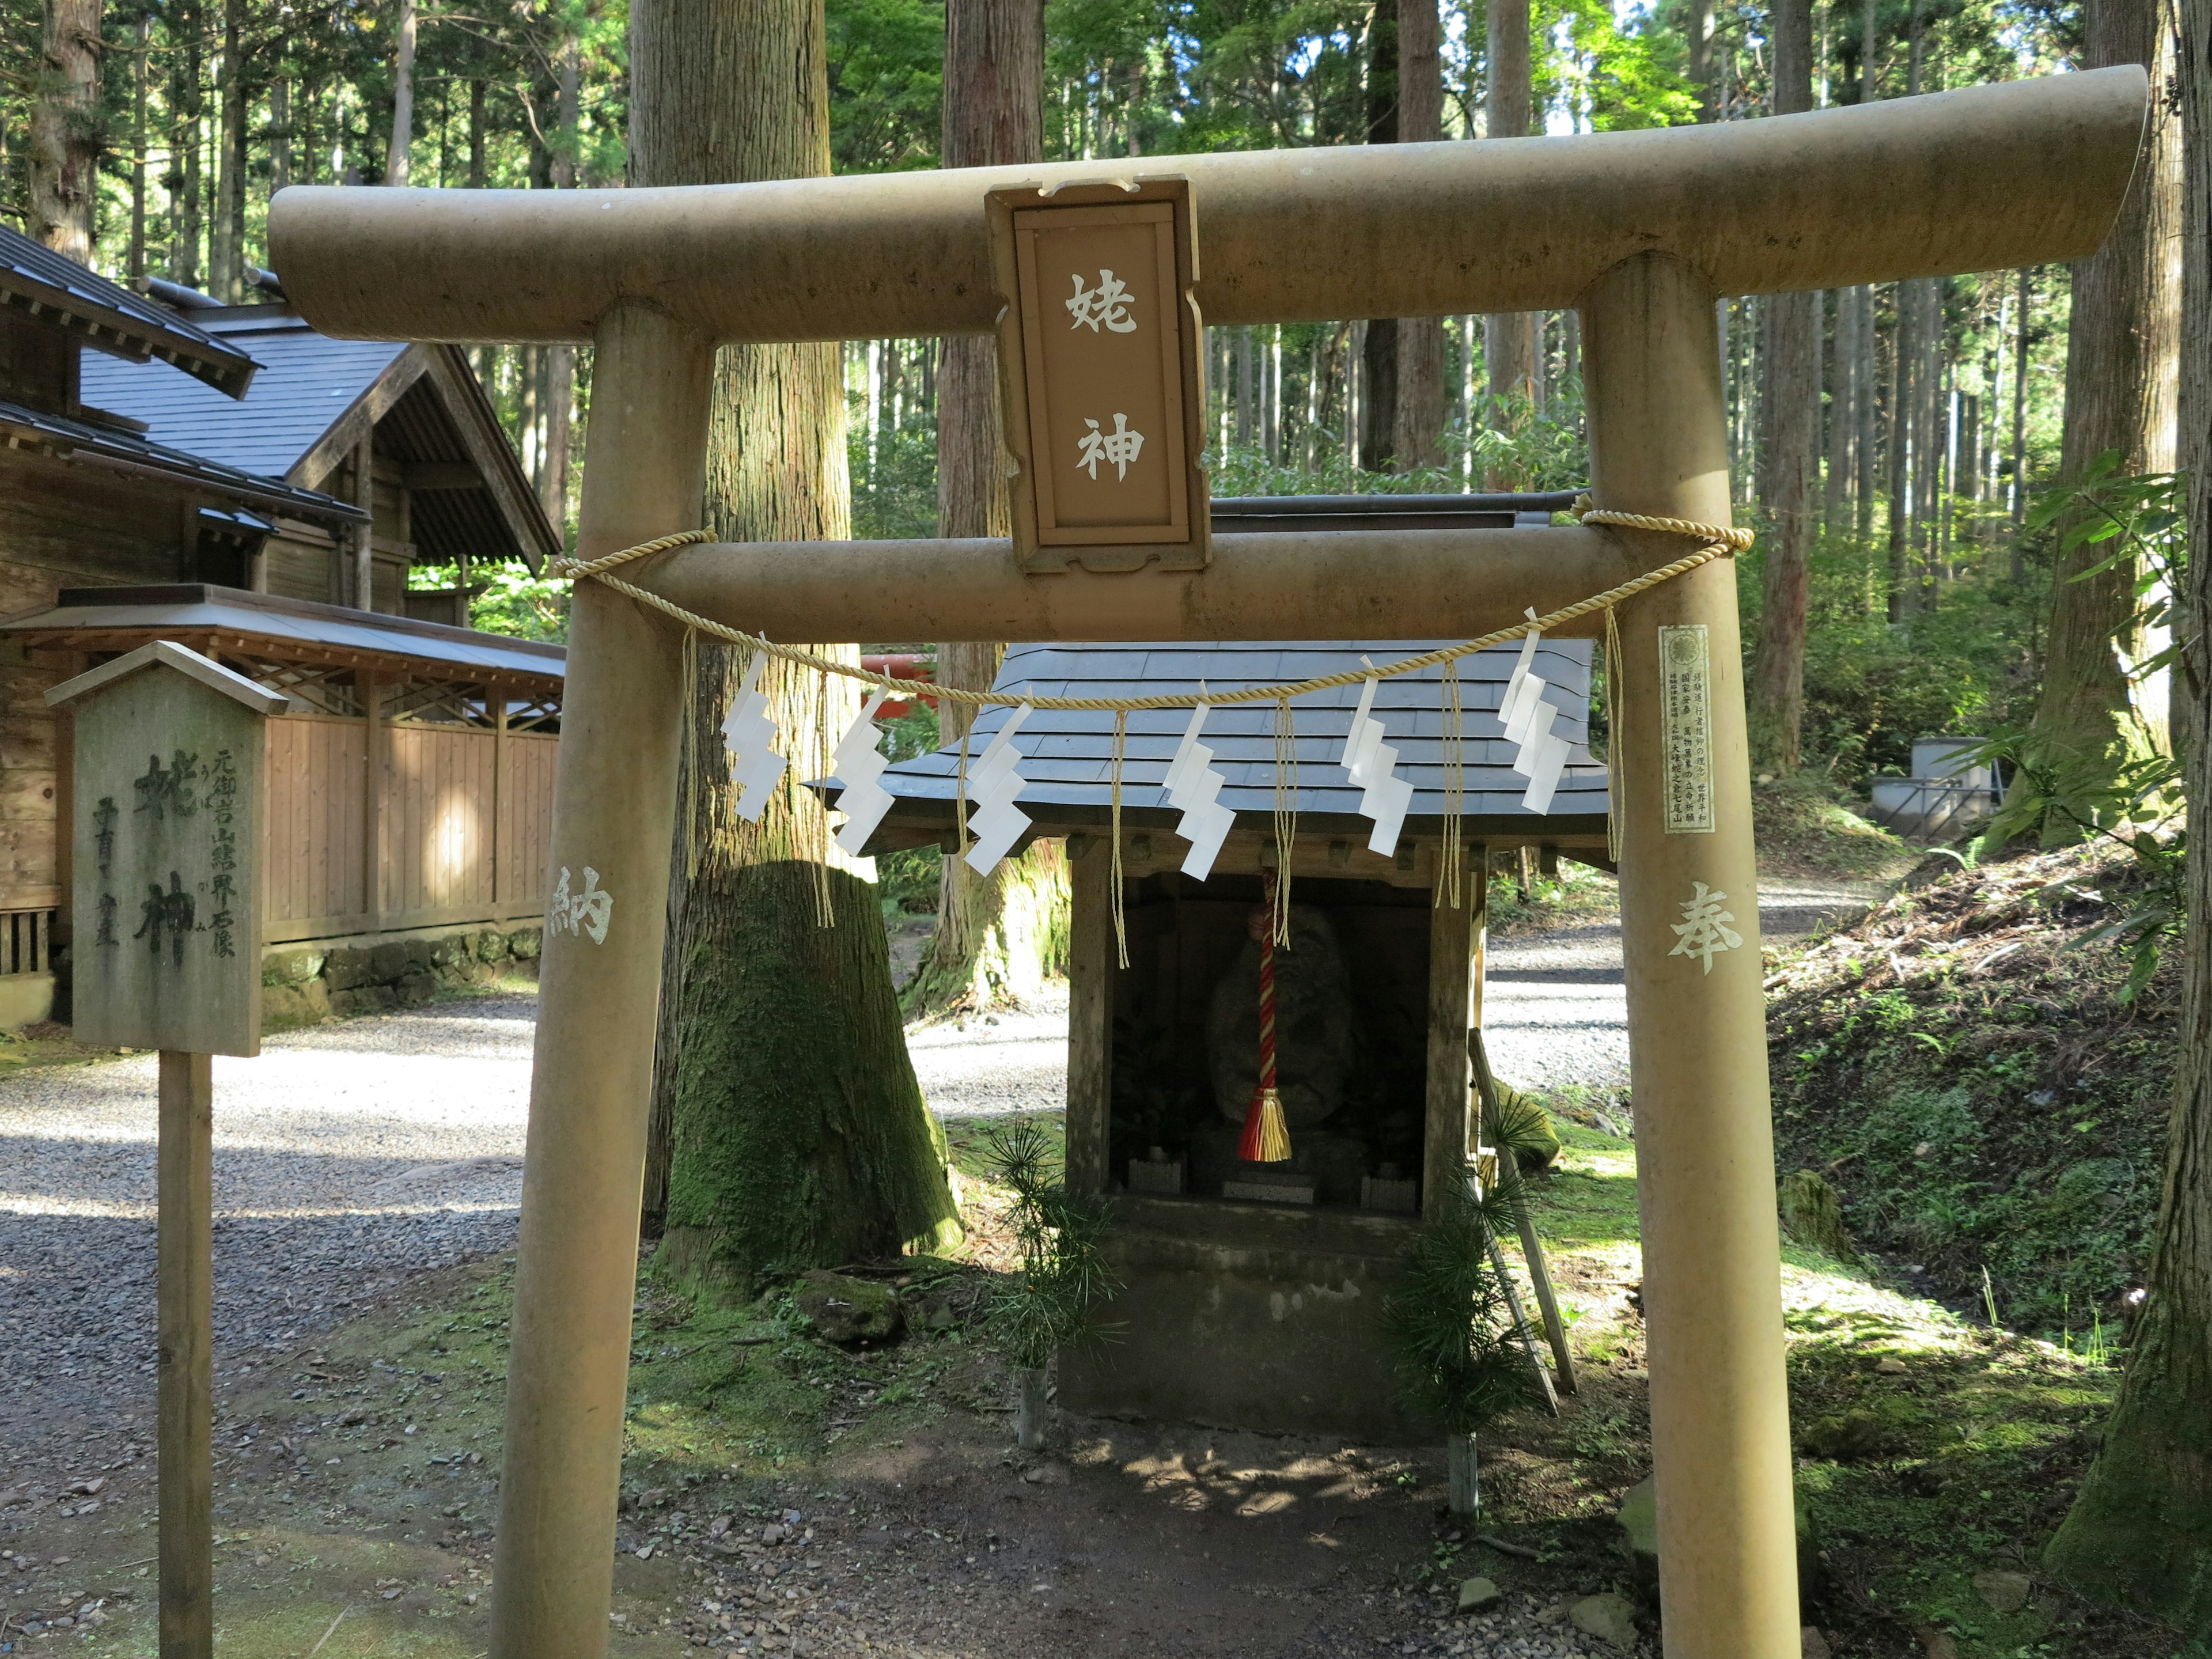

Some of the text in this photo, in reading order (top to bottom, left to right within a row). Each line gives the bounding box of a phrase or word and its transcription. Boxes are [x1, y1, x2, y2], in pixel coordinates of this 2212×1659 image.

[1065, 268, 1145, 483] 姥神
[1681, 673, 1691, 715] 国家安泰
[1696, 783, 1707, 823] 世界平和
[550, 866, 614, 945] 納
[1666, 881, 1744, 976] 奉
